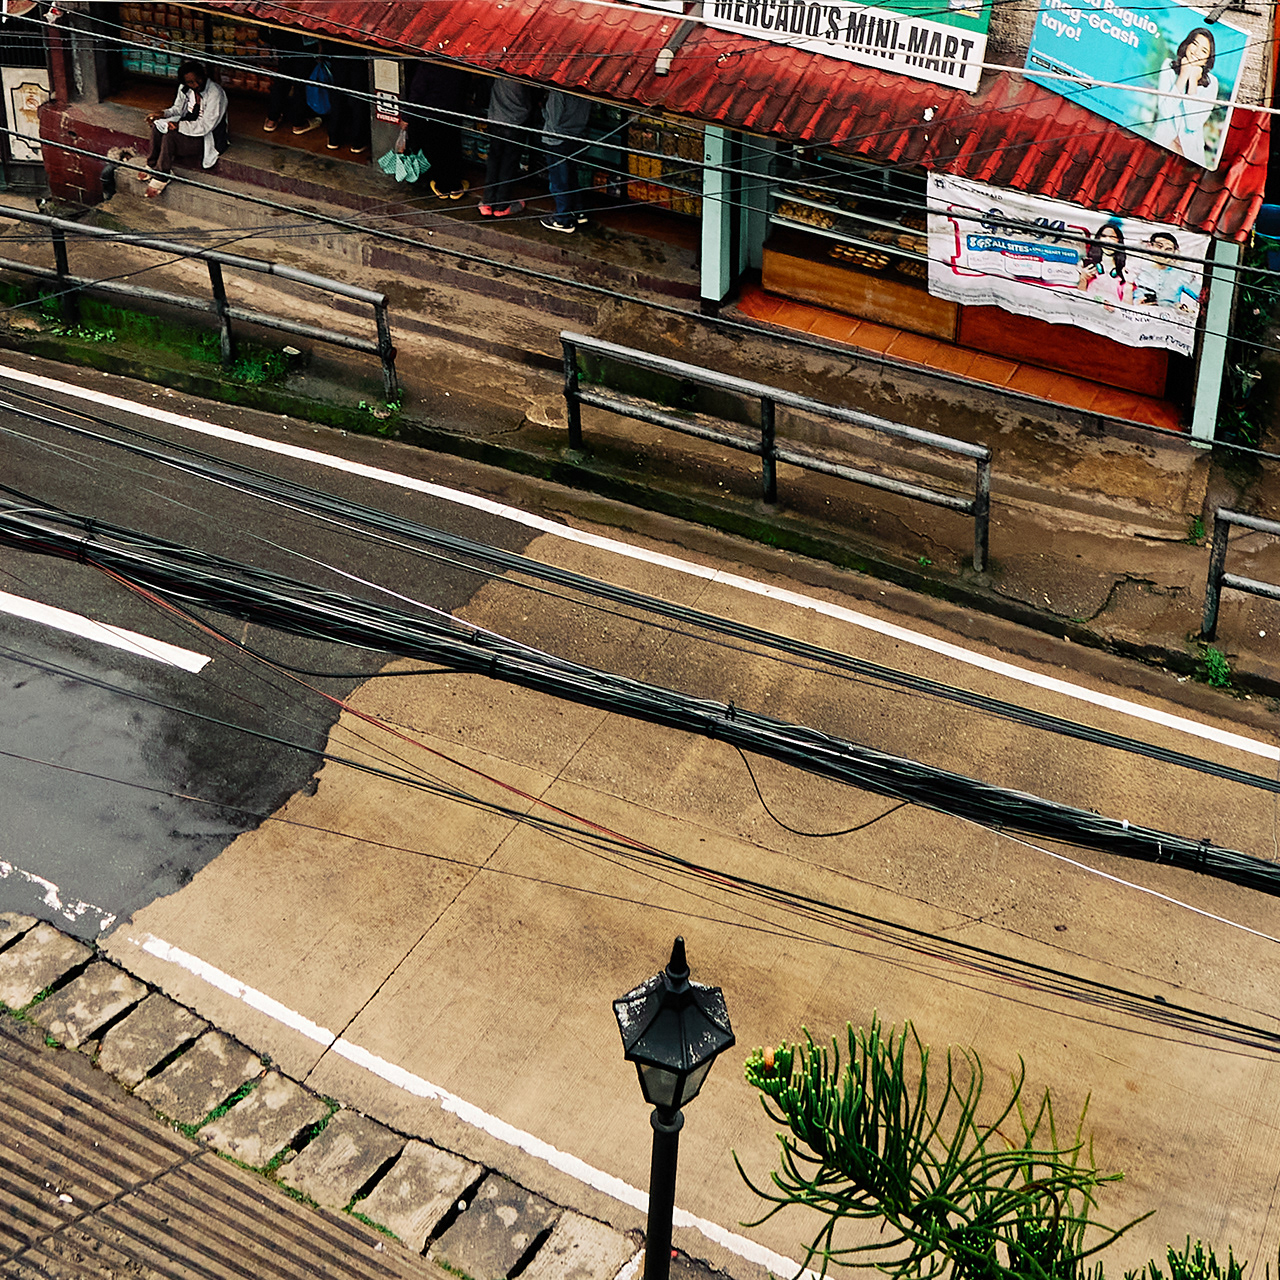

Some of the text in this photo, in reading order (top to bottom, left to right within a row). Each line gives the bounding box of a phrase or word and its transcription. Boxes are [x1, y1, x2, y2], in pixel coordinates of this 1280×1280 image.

[1041, 12, 1082, 42] tayo!
[845, 12, 974, 79] MINI-MART
[992, 240, 1007, 250] ALL
[1007, 243, 1030, 253] SITES
